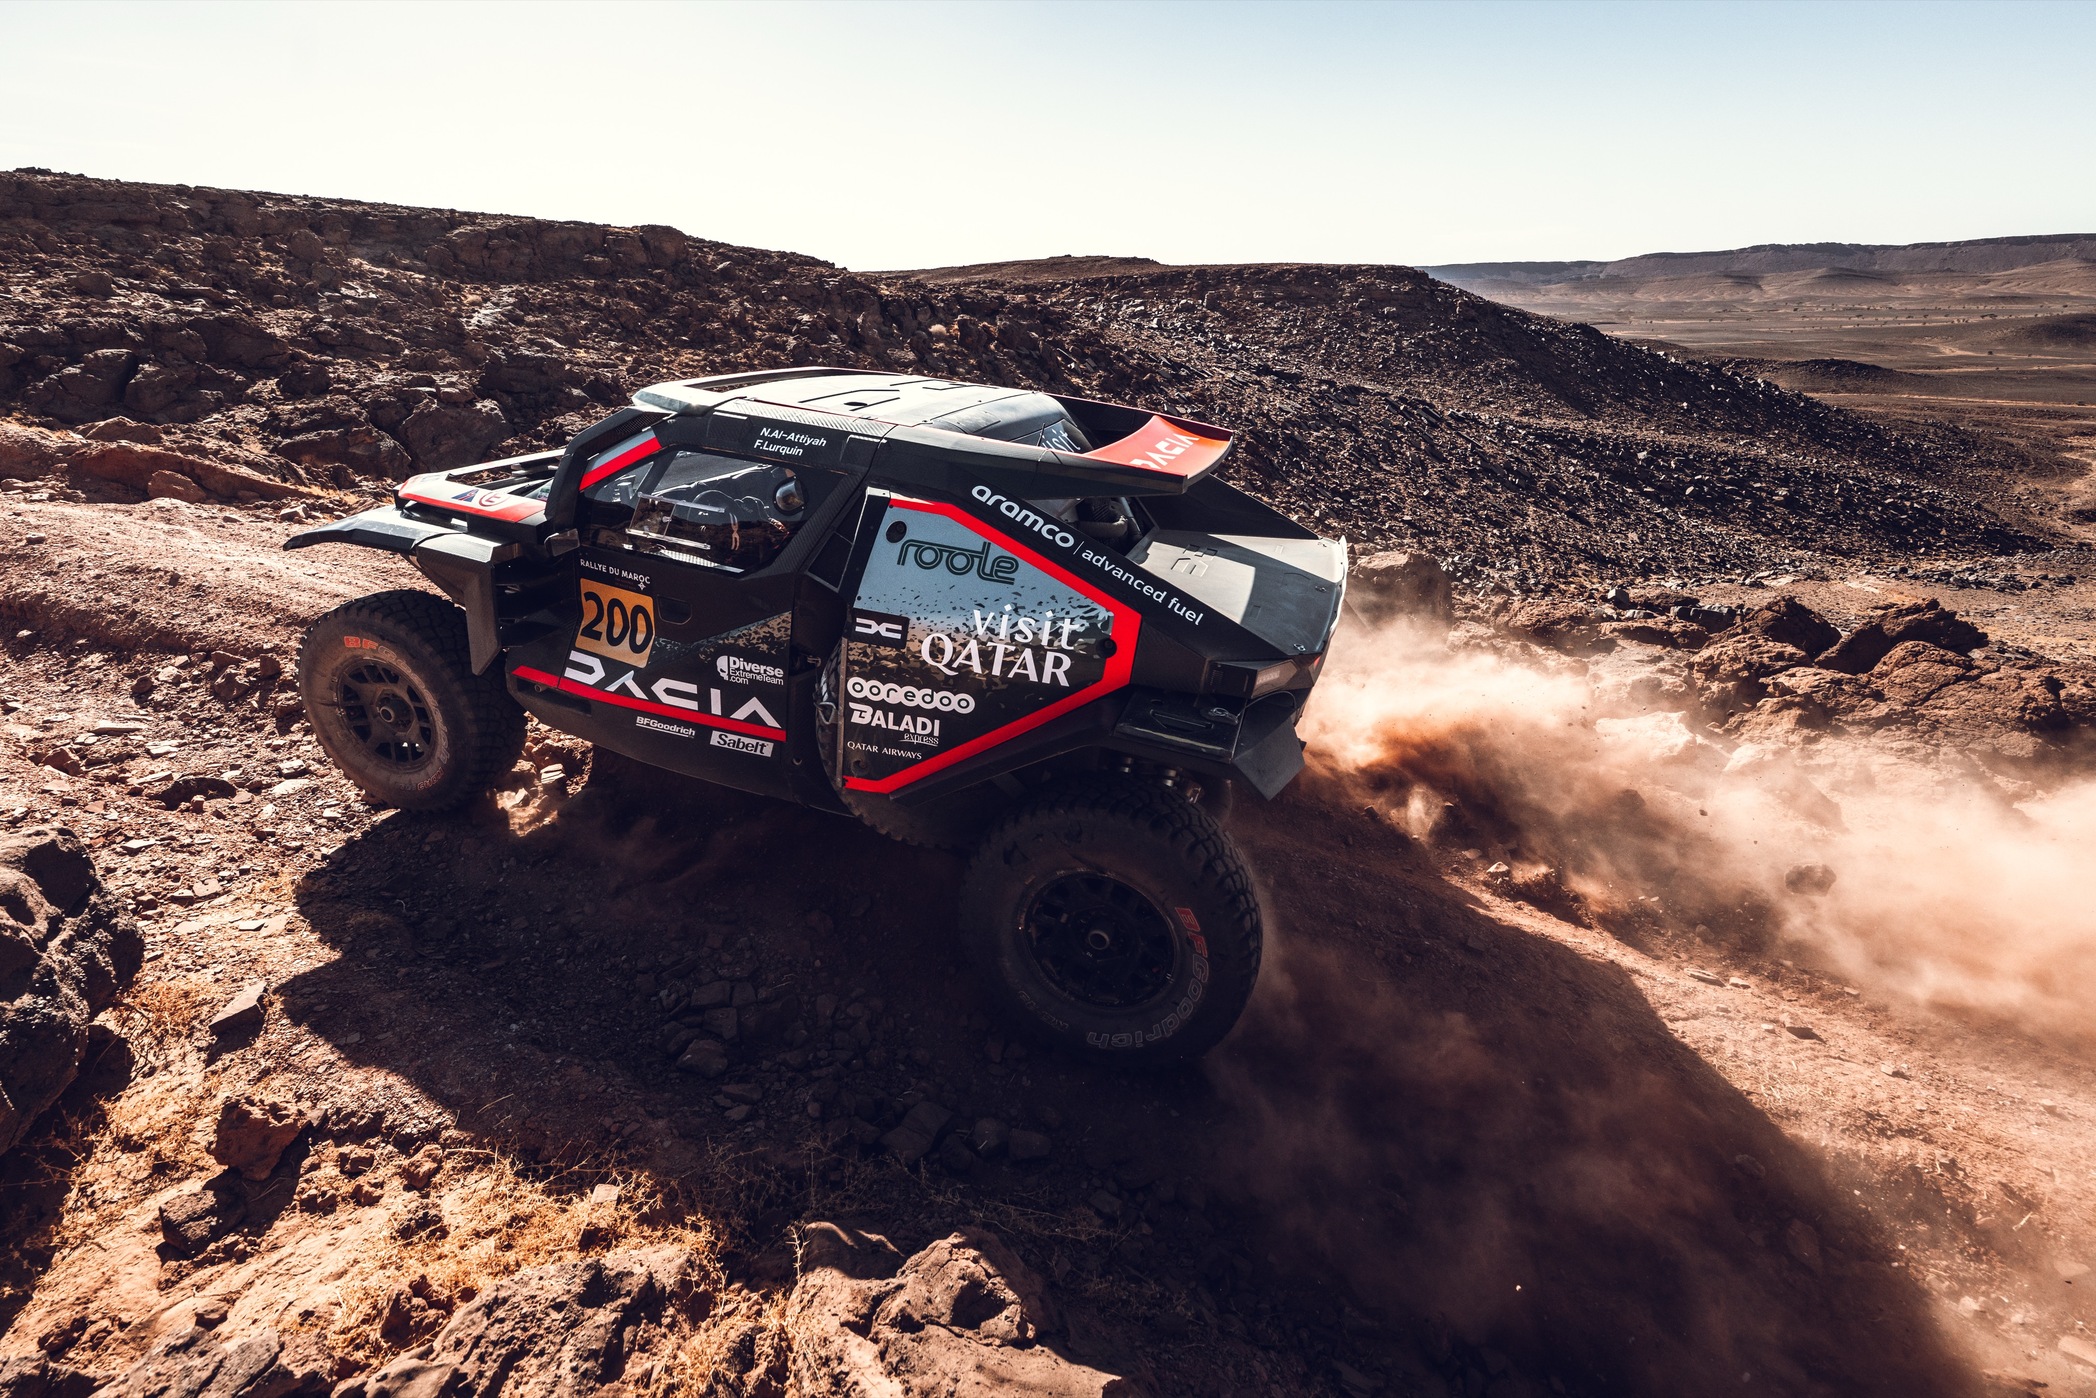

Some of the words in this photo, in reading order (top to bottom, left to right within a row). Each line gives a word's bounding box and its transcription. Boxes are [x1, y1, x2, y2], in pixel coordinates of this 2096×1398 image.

[753, 439, 803, 456] F.Lurquin
[971, 485, 1075, 548] aramco
[1081, 548, 1168, 604] advanced
[1167, 596, 1204, 626] fuel
[580, 559, 607, 573] RALLYE
[609, 566, 620, 576] DU
[621, 570, 651, 584] MAROC
[580, 591, 654, 654] 200
[973, 603, 1080, 651] visit
[729, 656, 784, 678] Diverse
[921, 632, 1072, 688] QATAR
[564, 650, 782, 729] DACIA
[729, 675, 749, 685] .com
[848, 678, 974, 713] ooredoo
[636, 716, 696, 737] BFGoodrich
[849, 702, 940, 737] BALADI
[717, 733, 767, 755] Sabelt
[847, 741, 879, 753] QATAR
[881, 747, 922, 760] AIRWAYS
[904, 733, 939, 745] express
[1086, 906, 1209, 1049] BFGoodrich
